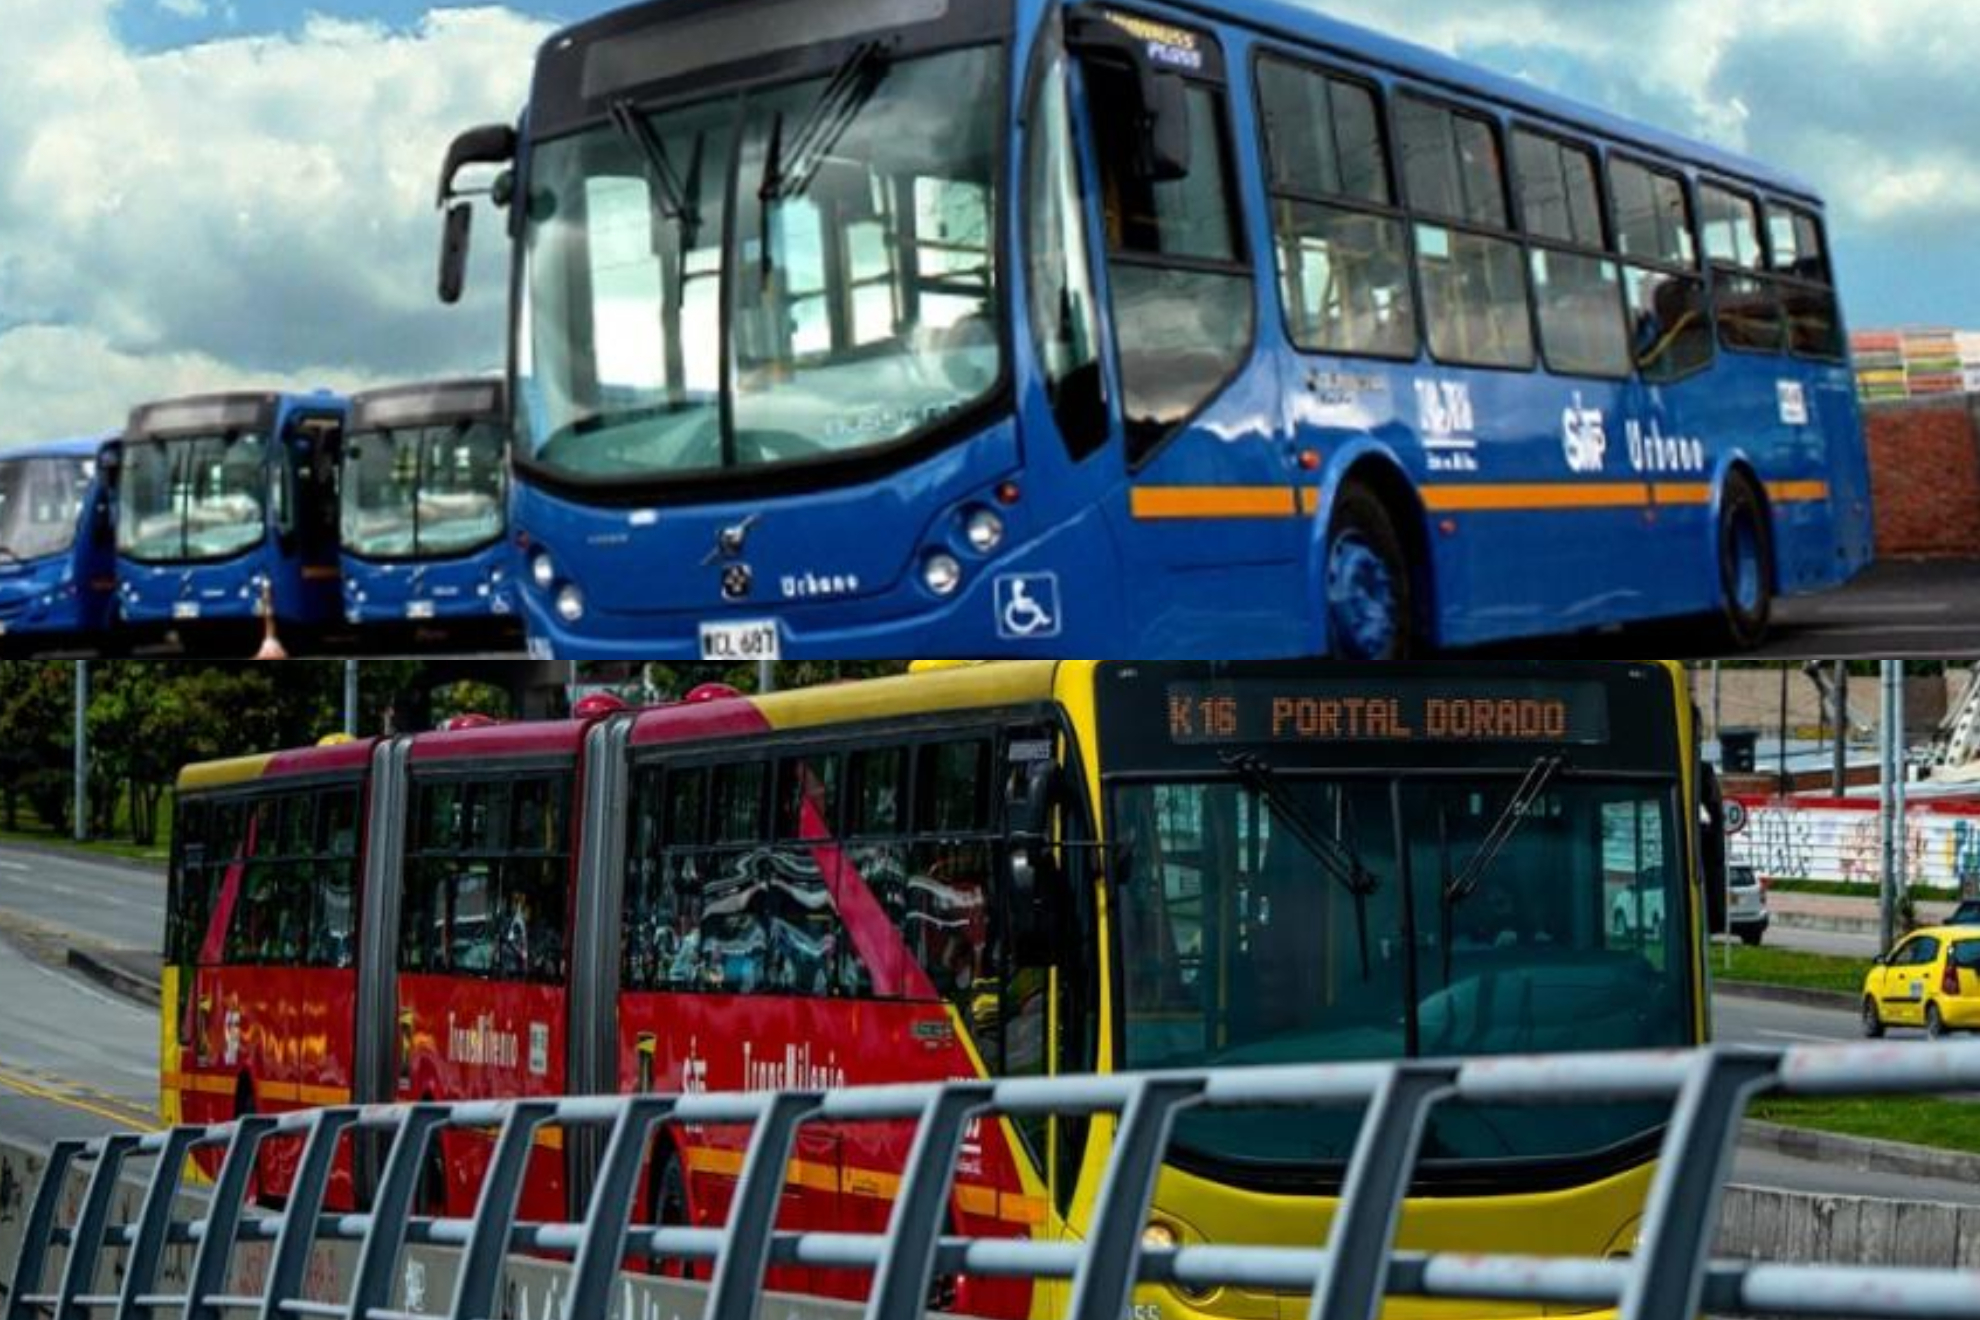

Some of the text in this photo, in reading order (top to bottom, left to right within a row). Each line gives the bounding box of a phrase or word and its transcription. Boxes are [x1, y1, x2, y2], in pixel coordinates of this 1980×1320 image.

[1624, 417, 1703, 470] Urbano
[781, 573, 859, 597] Urbano
[1272, 697, 1411, 736] PORTAL
[1426, 698, 1566, 736] DORADO
